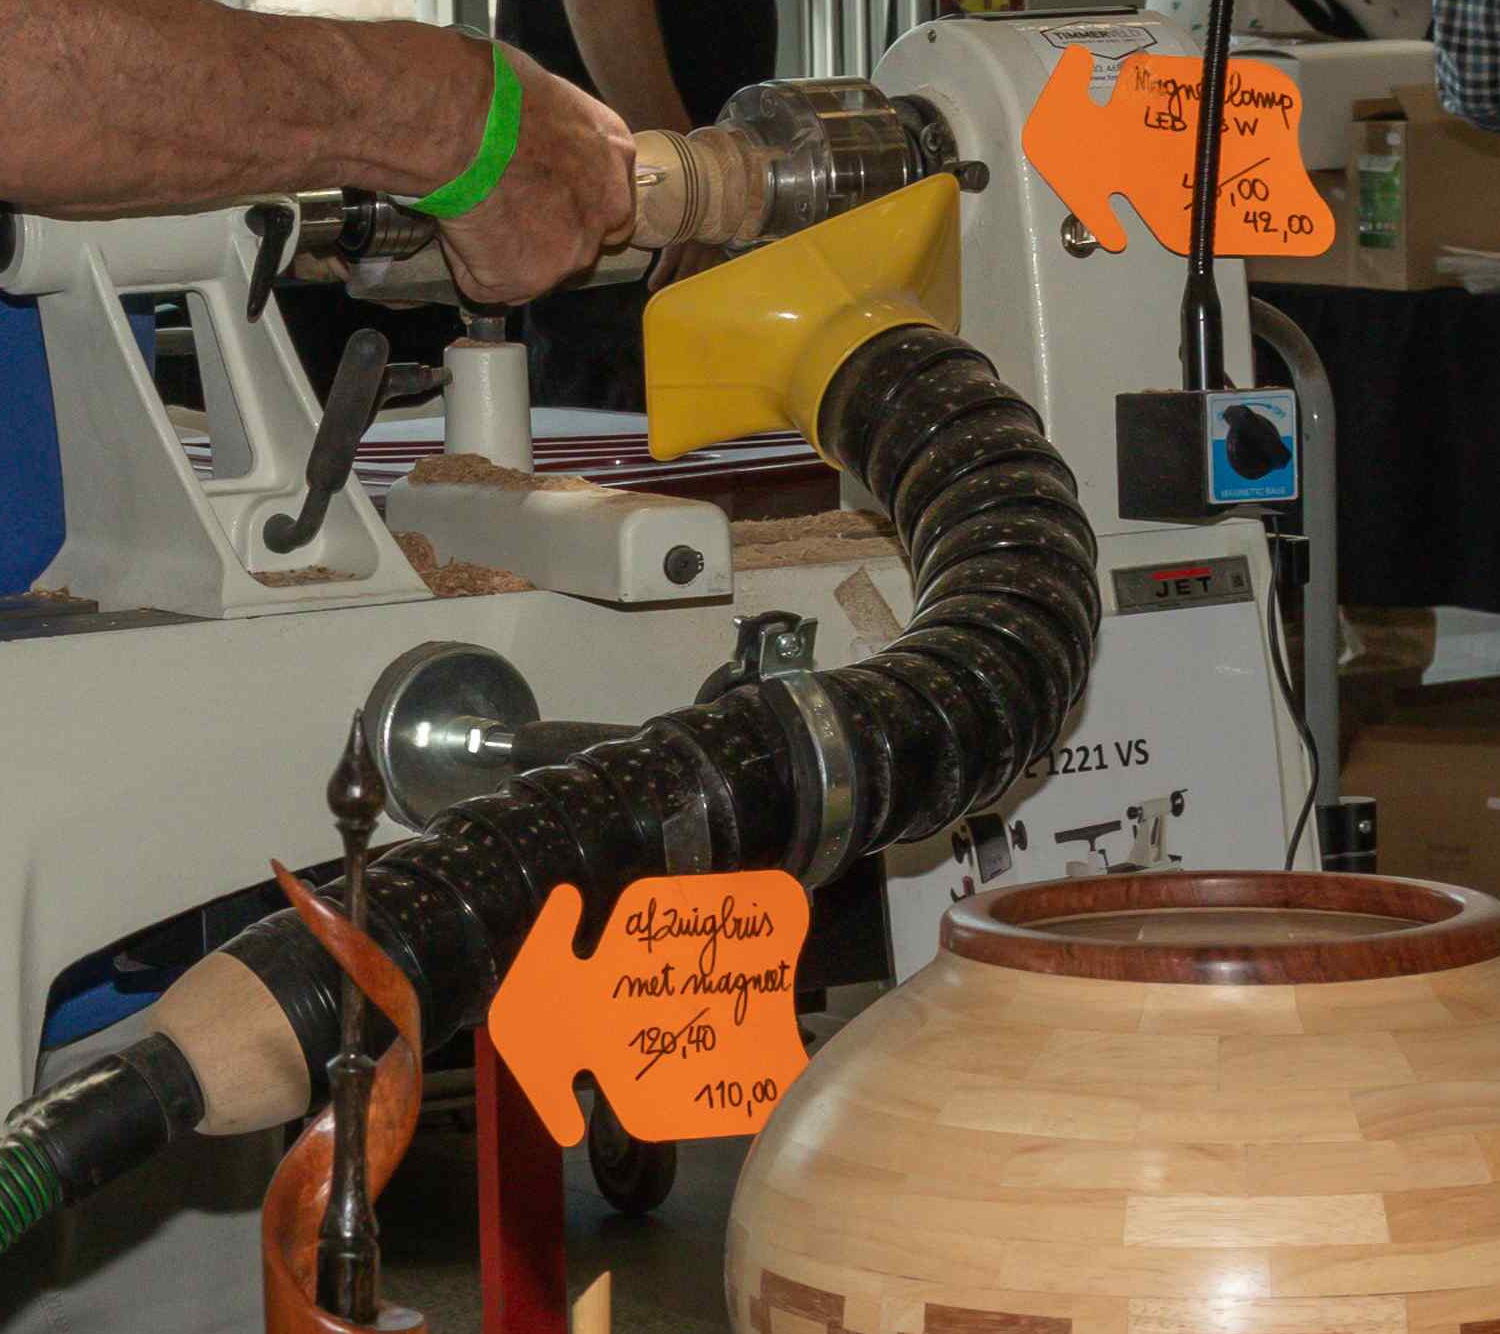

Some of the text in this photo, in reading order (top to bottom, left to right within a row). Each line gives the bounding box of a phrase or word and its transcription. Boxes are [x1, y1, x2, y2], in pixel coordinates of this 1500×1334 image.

[1144, 106, 1188, 133] LED
[1243, 210, 1314, 244] 42,00
[1155, 574, 1212, 598] JET
[1047, 743, 1109, 777] 1221
[1114, 738, 1151, 768] VS
[625, 895, 775, 977] afzuigbuis
[612, 963, 676, 1000] met
[694, 1078, 779, 1118] 110,00
